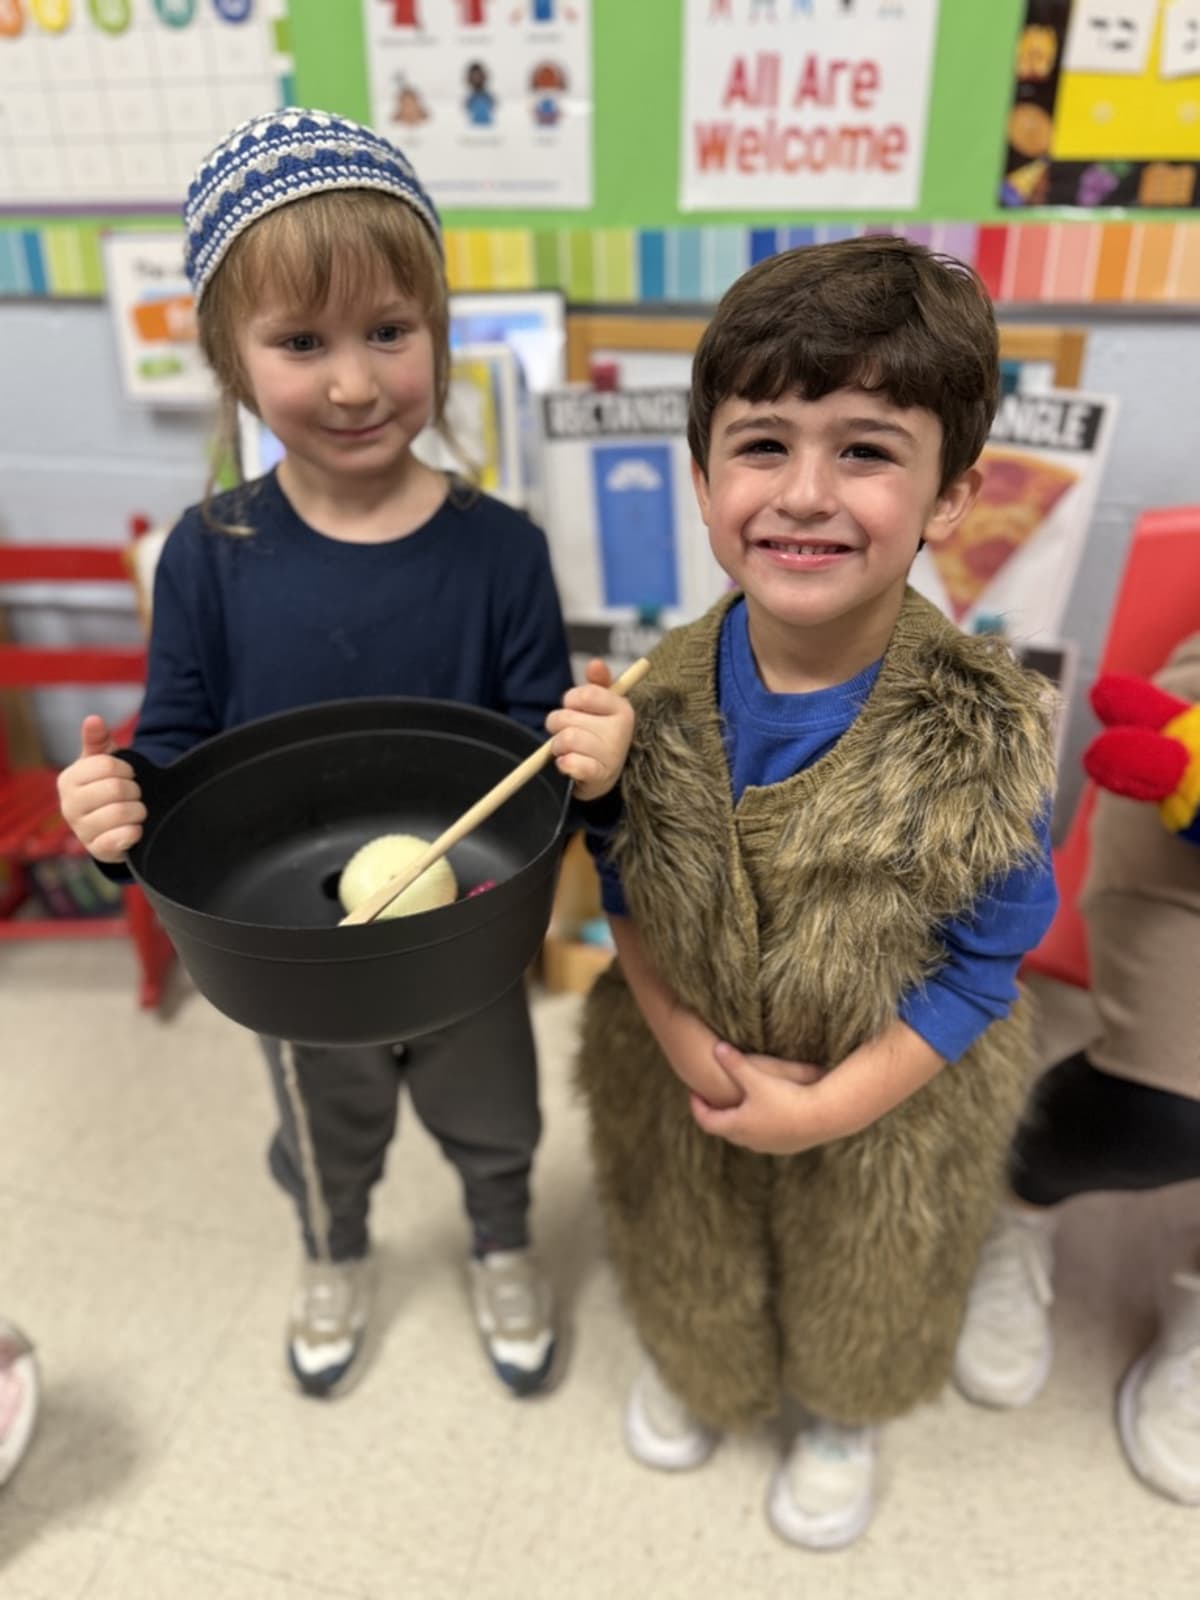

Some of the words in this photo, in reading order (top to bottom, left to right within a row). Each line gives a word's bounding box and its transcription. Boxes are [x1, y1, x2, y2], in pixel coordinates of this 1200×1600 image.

[722, 51, 781, 110] All
[791, 52, 882, 110] Are
[693, 117, 909, 175] Welcome
